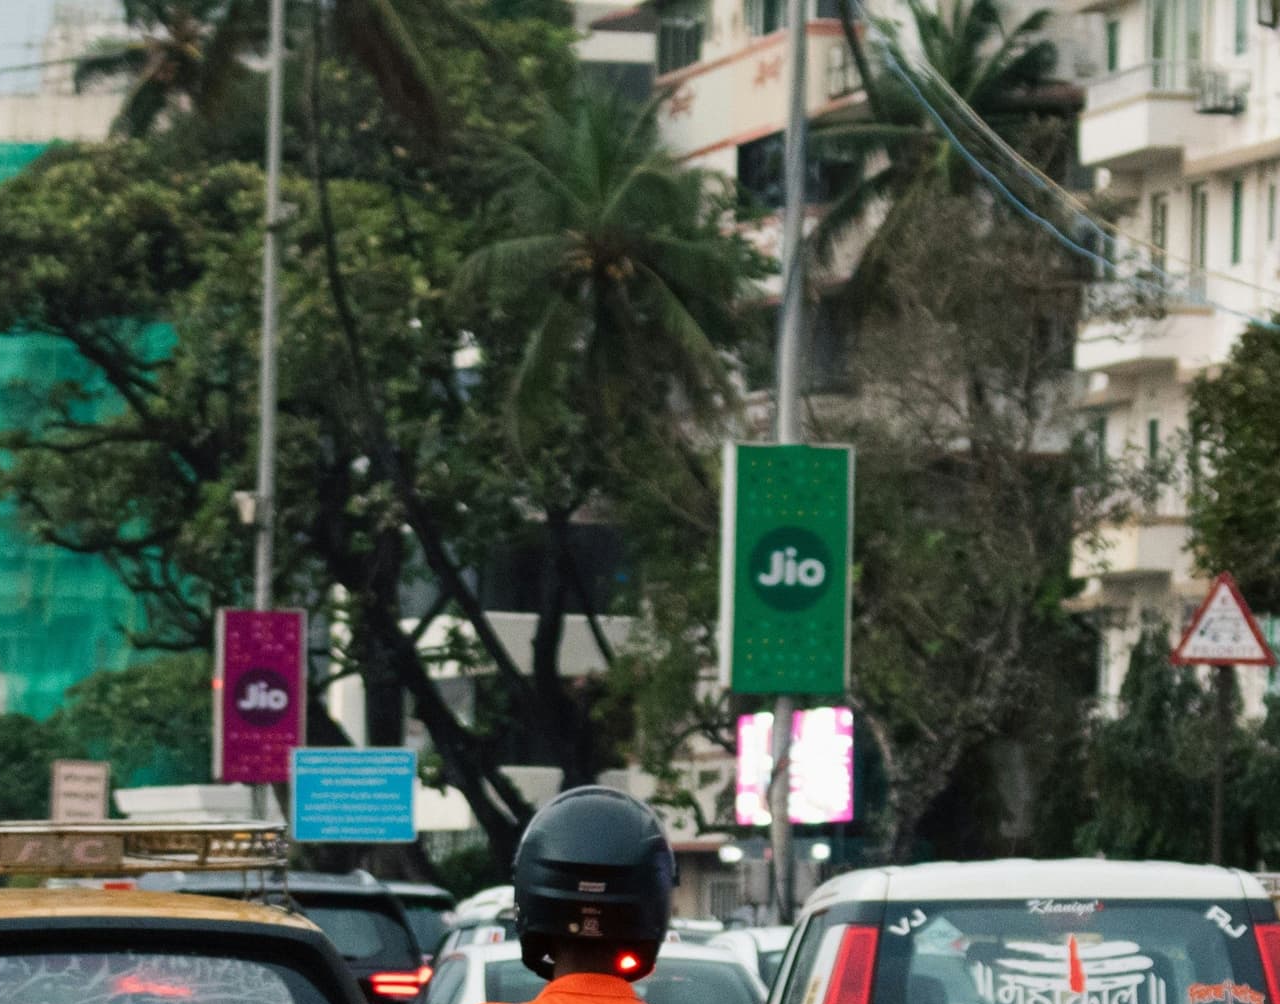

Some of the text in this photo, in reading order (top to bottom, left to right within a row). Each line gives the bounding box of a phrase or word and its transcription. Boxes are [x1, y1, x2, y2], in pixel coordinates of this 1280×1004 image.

[758, 546, 826, 587] Jio
[237, 681, 289, 711] Jio
[887, 907, 927, 936] VJ
